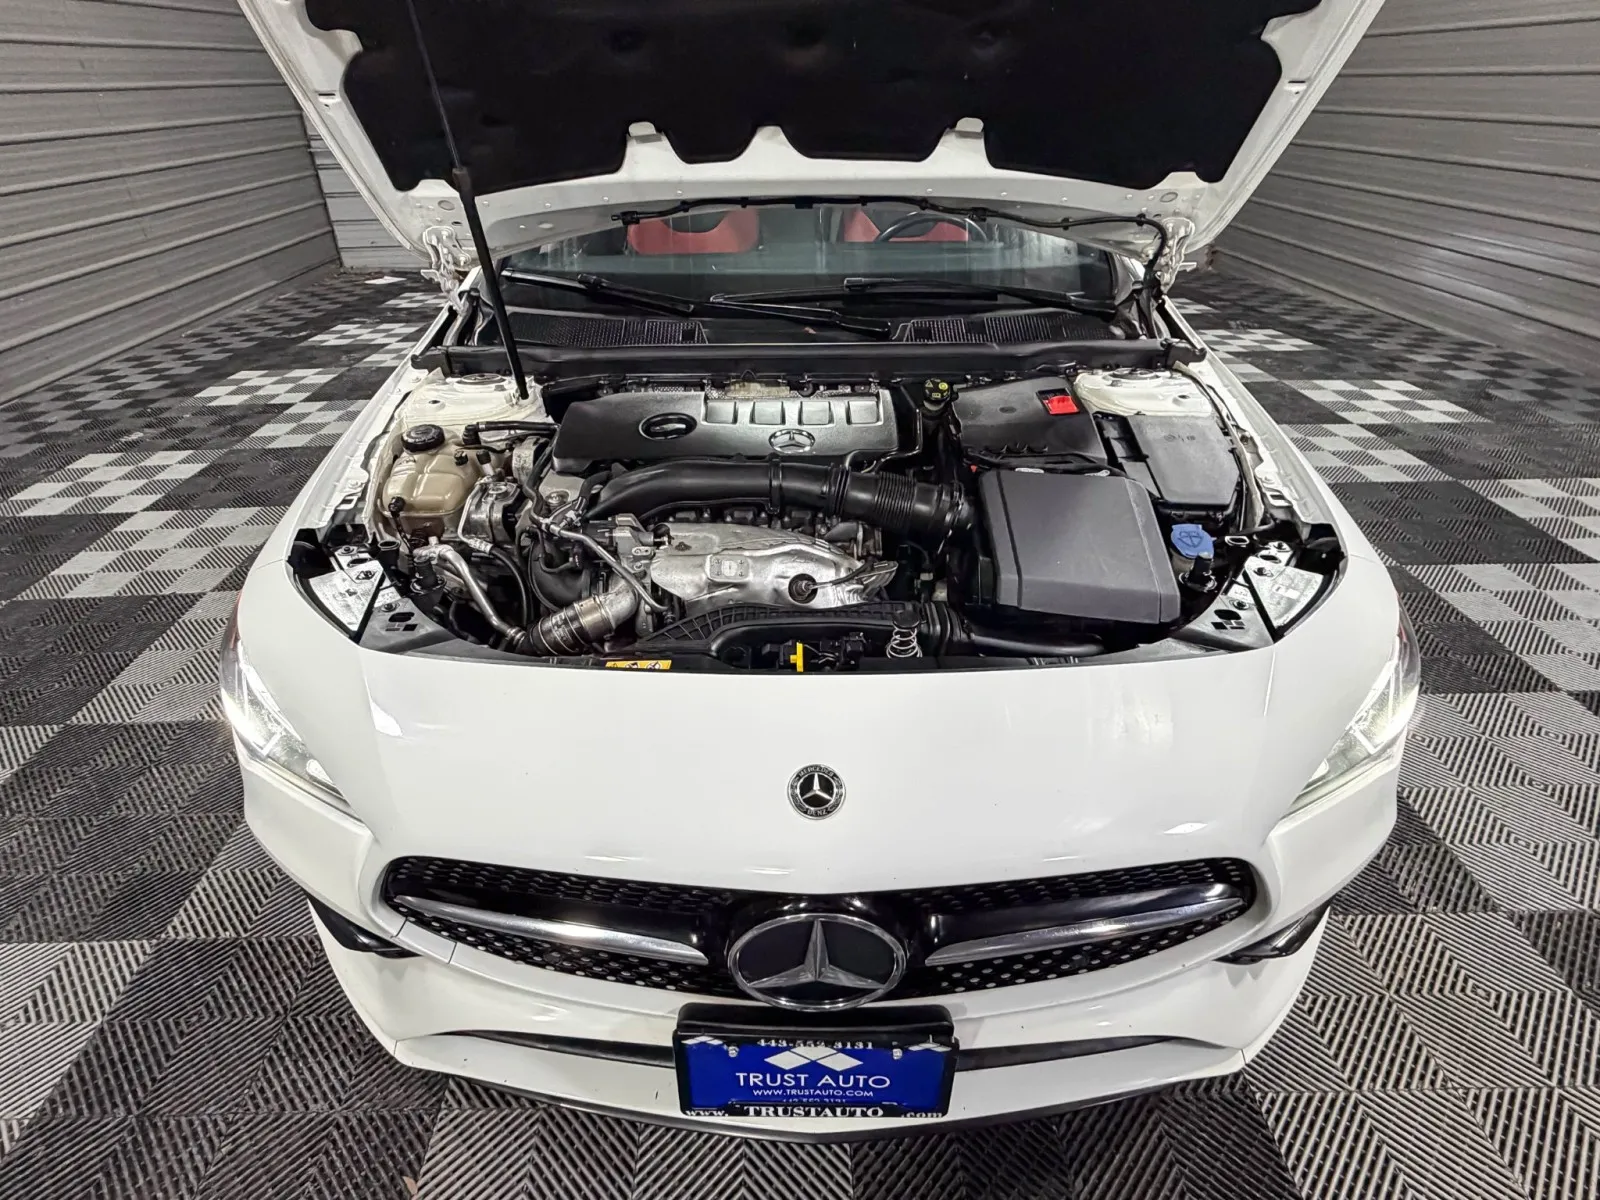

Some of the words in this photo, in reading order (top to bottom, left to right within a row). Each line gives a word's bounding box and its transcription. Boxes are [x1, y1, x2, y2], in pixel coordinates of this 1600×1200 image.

[735, 1073, 808, 1087] TRUST
[817, 1075, 890, 1088] AUTO
[753, 1089, 873, 1097] WWW.TRUSTAUTO.COM
[744, 1106, 884, 1118] TRUSTAUTO
